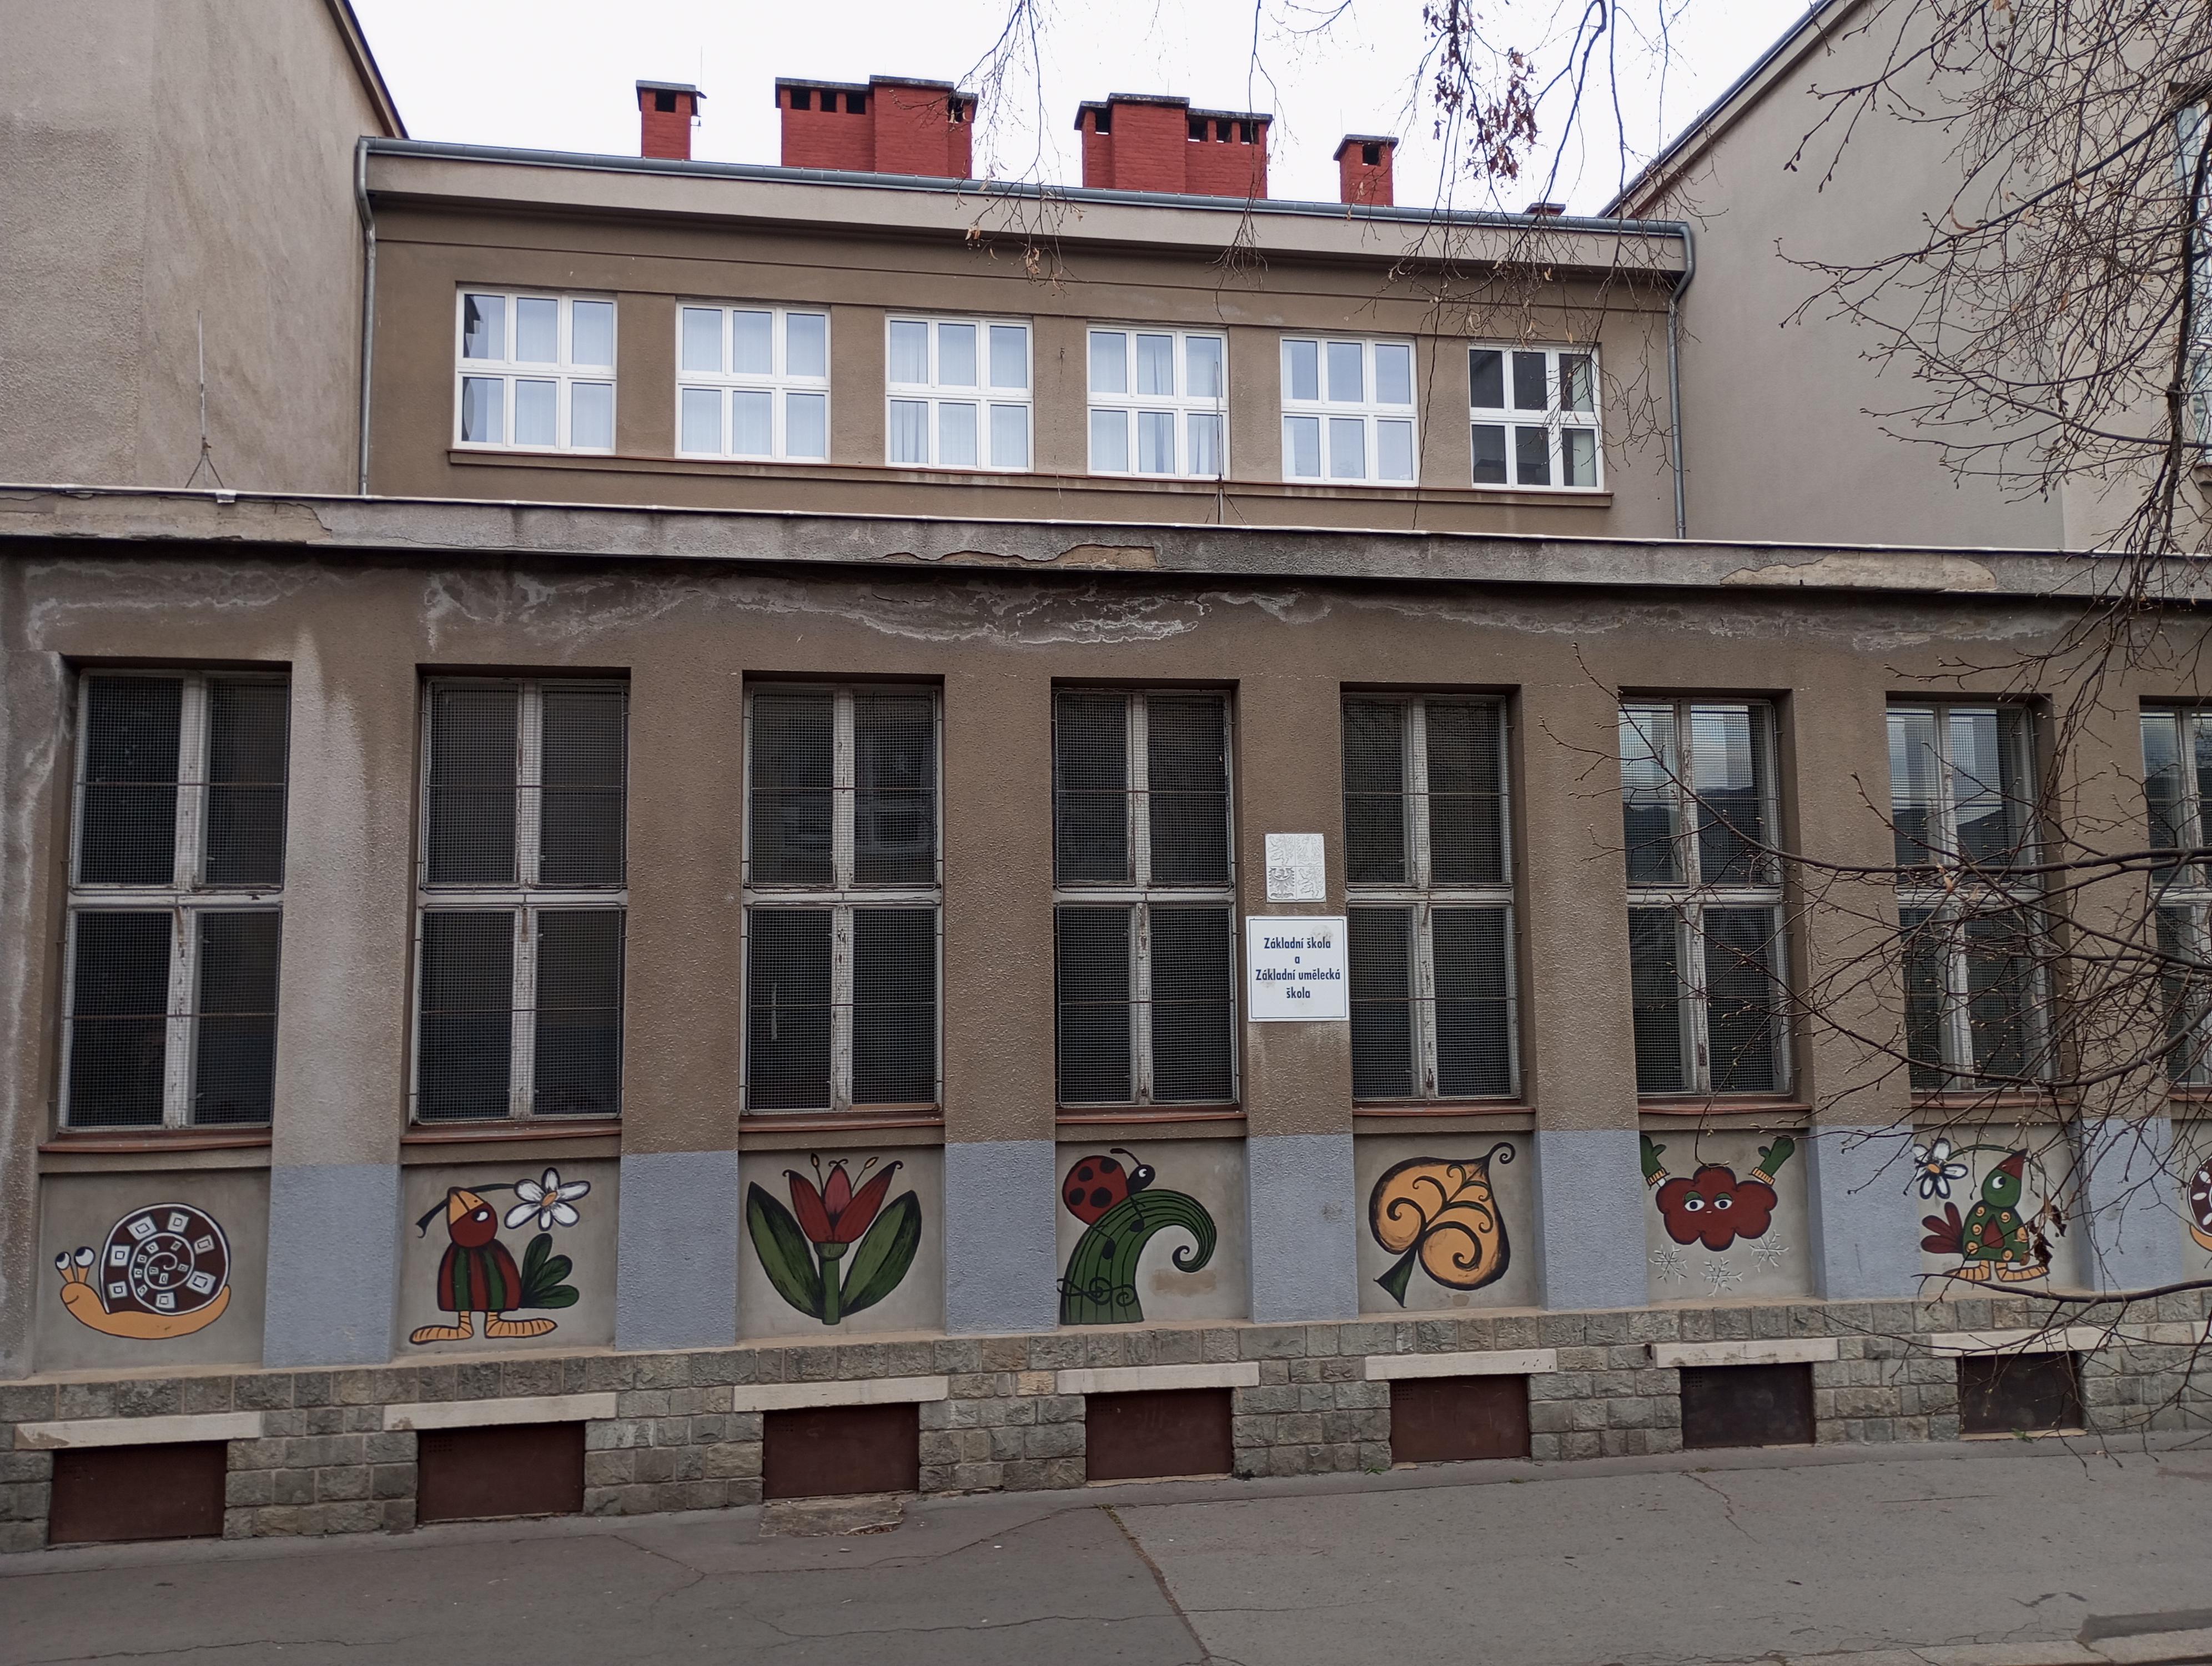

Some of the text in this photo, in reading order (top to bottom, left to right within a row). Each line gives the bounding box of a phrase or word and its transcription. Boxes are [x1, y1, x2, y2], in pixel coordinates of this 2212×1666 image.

[1264, 936, 1331, 949] Základní škola
[1255, 969, 1340, 981] Základní umělecká
[1286, 987, 1310, 998] škola
